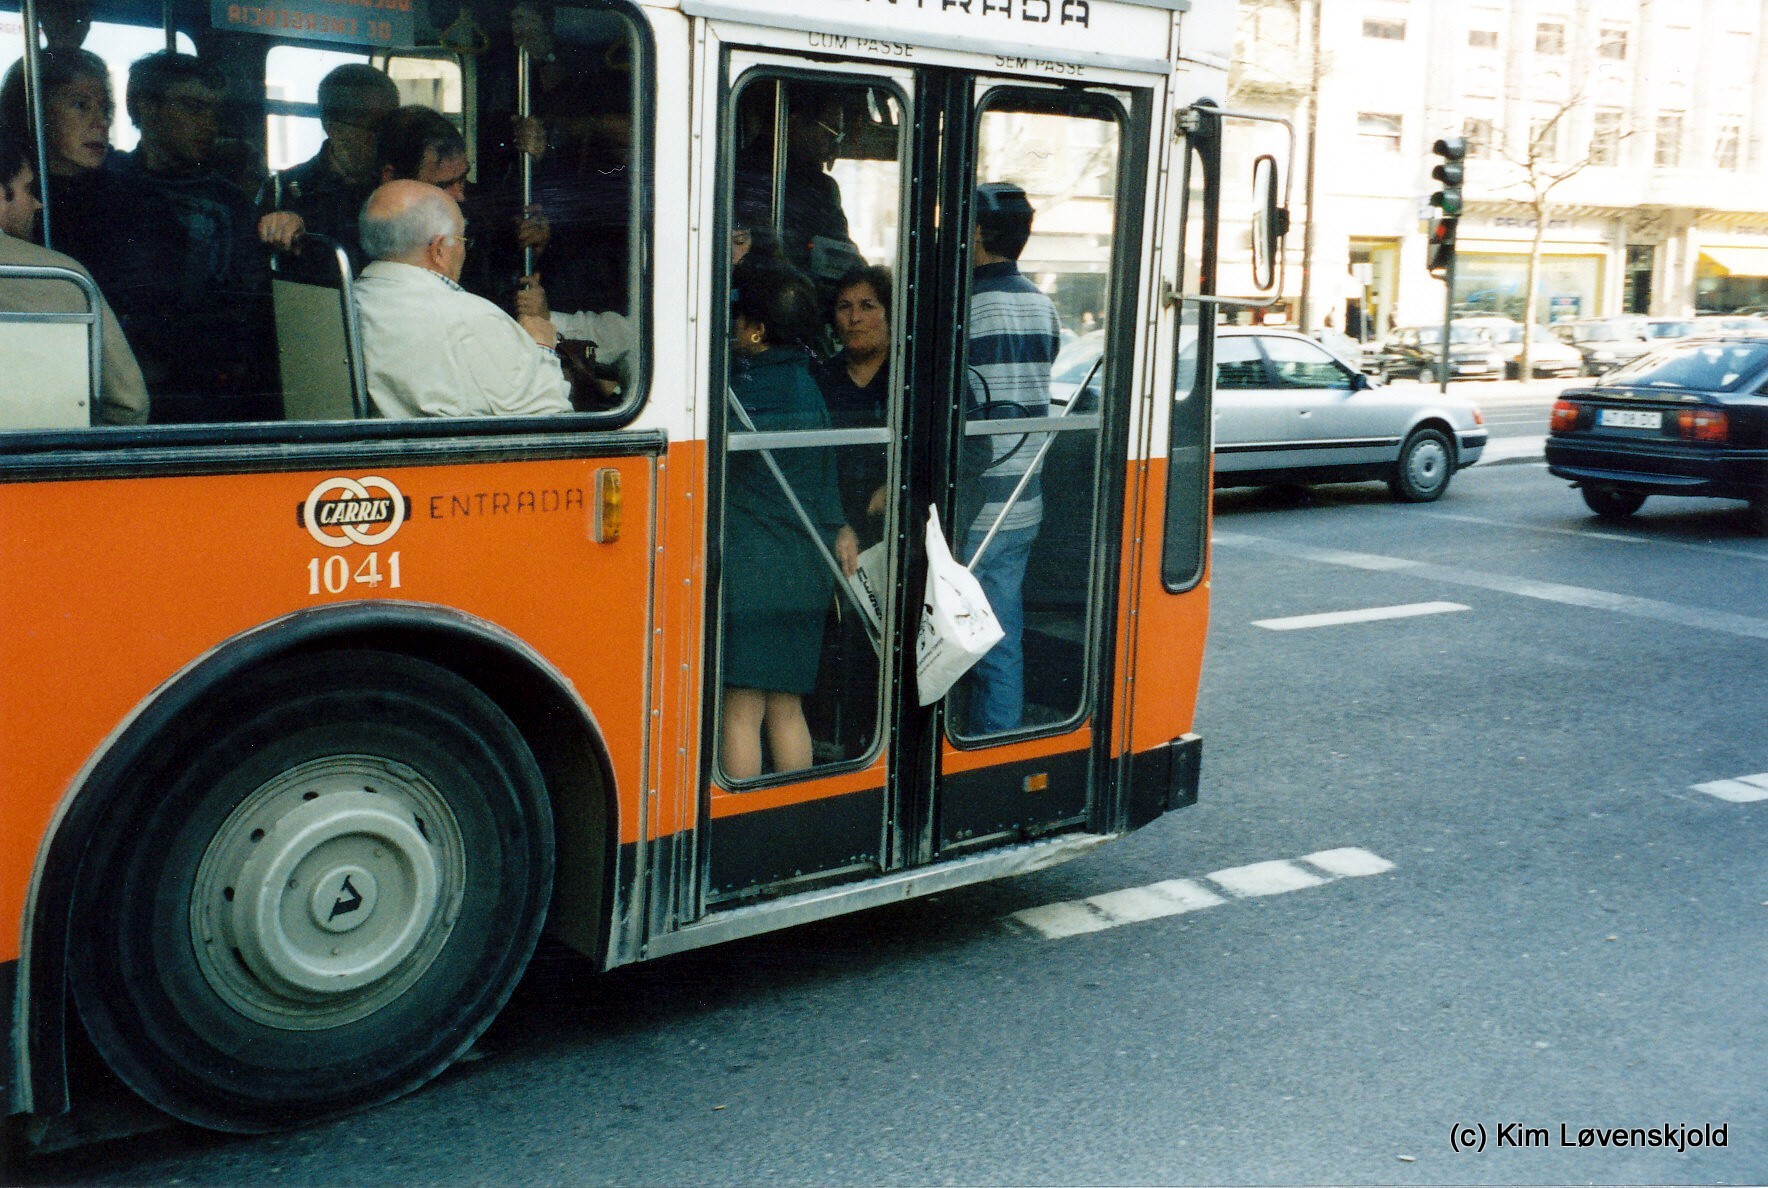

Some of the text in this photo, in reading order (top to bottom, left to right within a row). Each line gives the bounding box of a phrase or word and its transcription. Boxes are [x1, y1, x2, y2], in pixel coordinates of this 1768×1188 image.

[320, 499, 391, 525] CARRIS
[430, 488, 583, 520] ENTRADA
[307, 551, 402, 594] 1041
